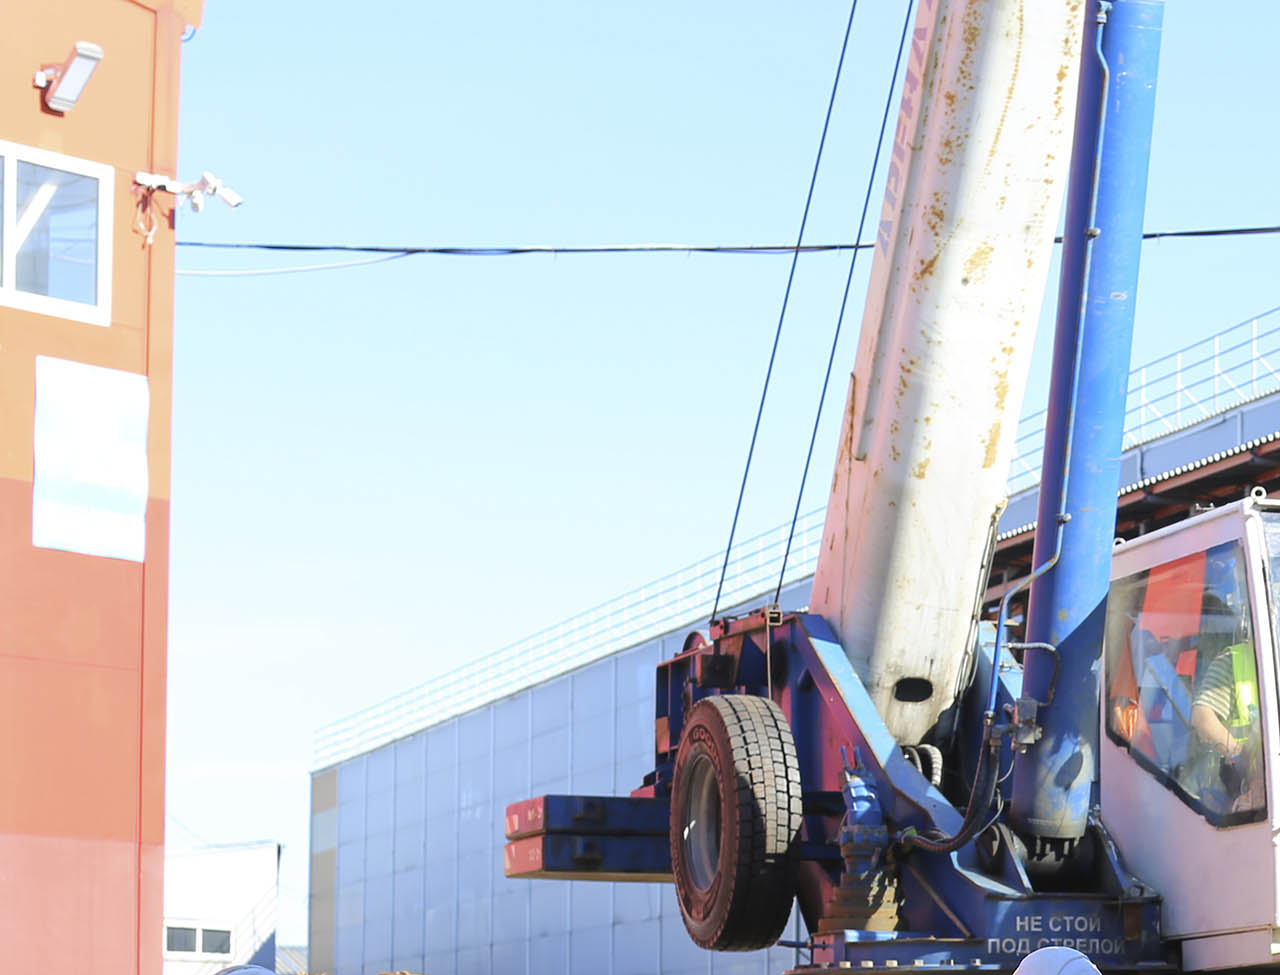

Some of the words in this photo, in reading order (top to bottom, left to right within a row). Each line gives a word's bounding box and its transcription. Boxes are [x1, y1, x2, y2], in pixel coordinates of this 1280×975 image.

[1016, 916, 1042, 932] НЕ
[1049, 913, 1101, 932] СТОЙ
[987, 938, 1030, 956] ПОД
[1036, 936, 1126, 955] СТРЕЛОЙ
